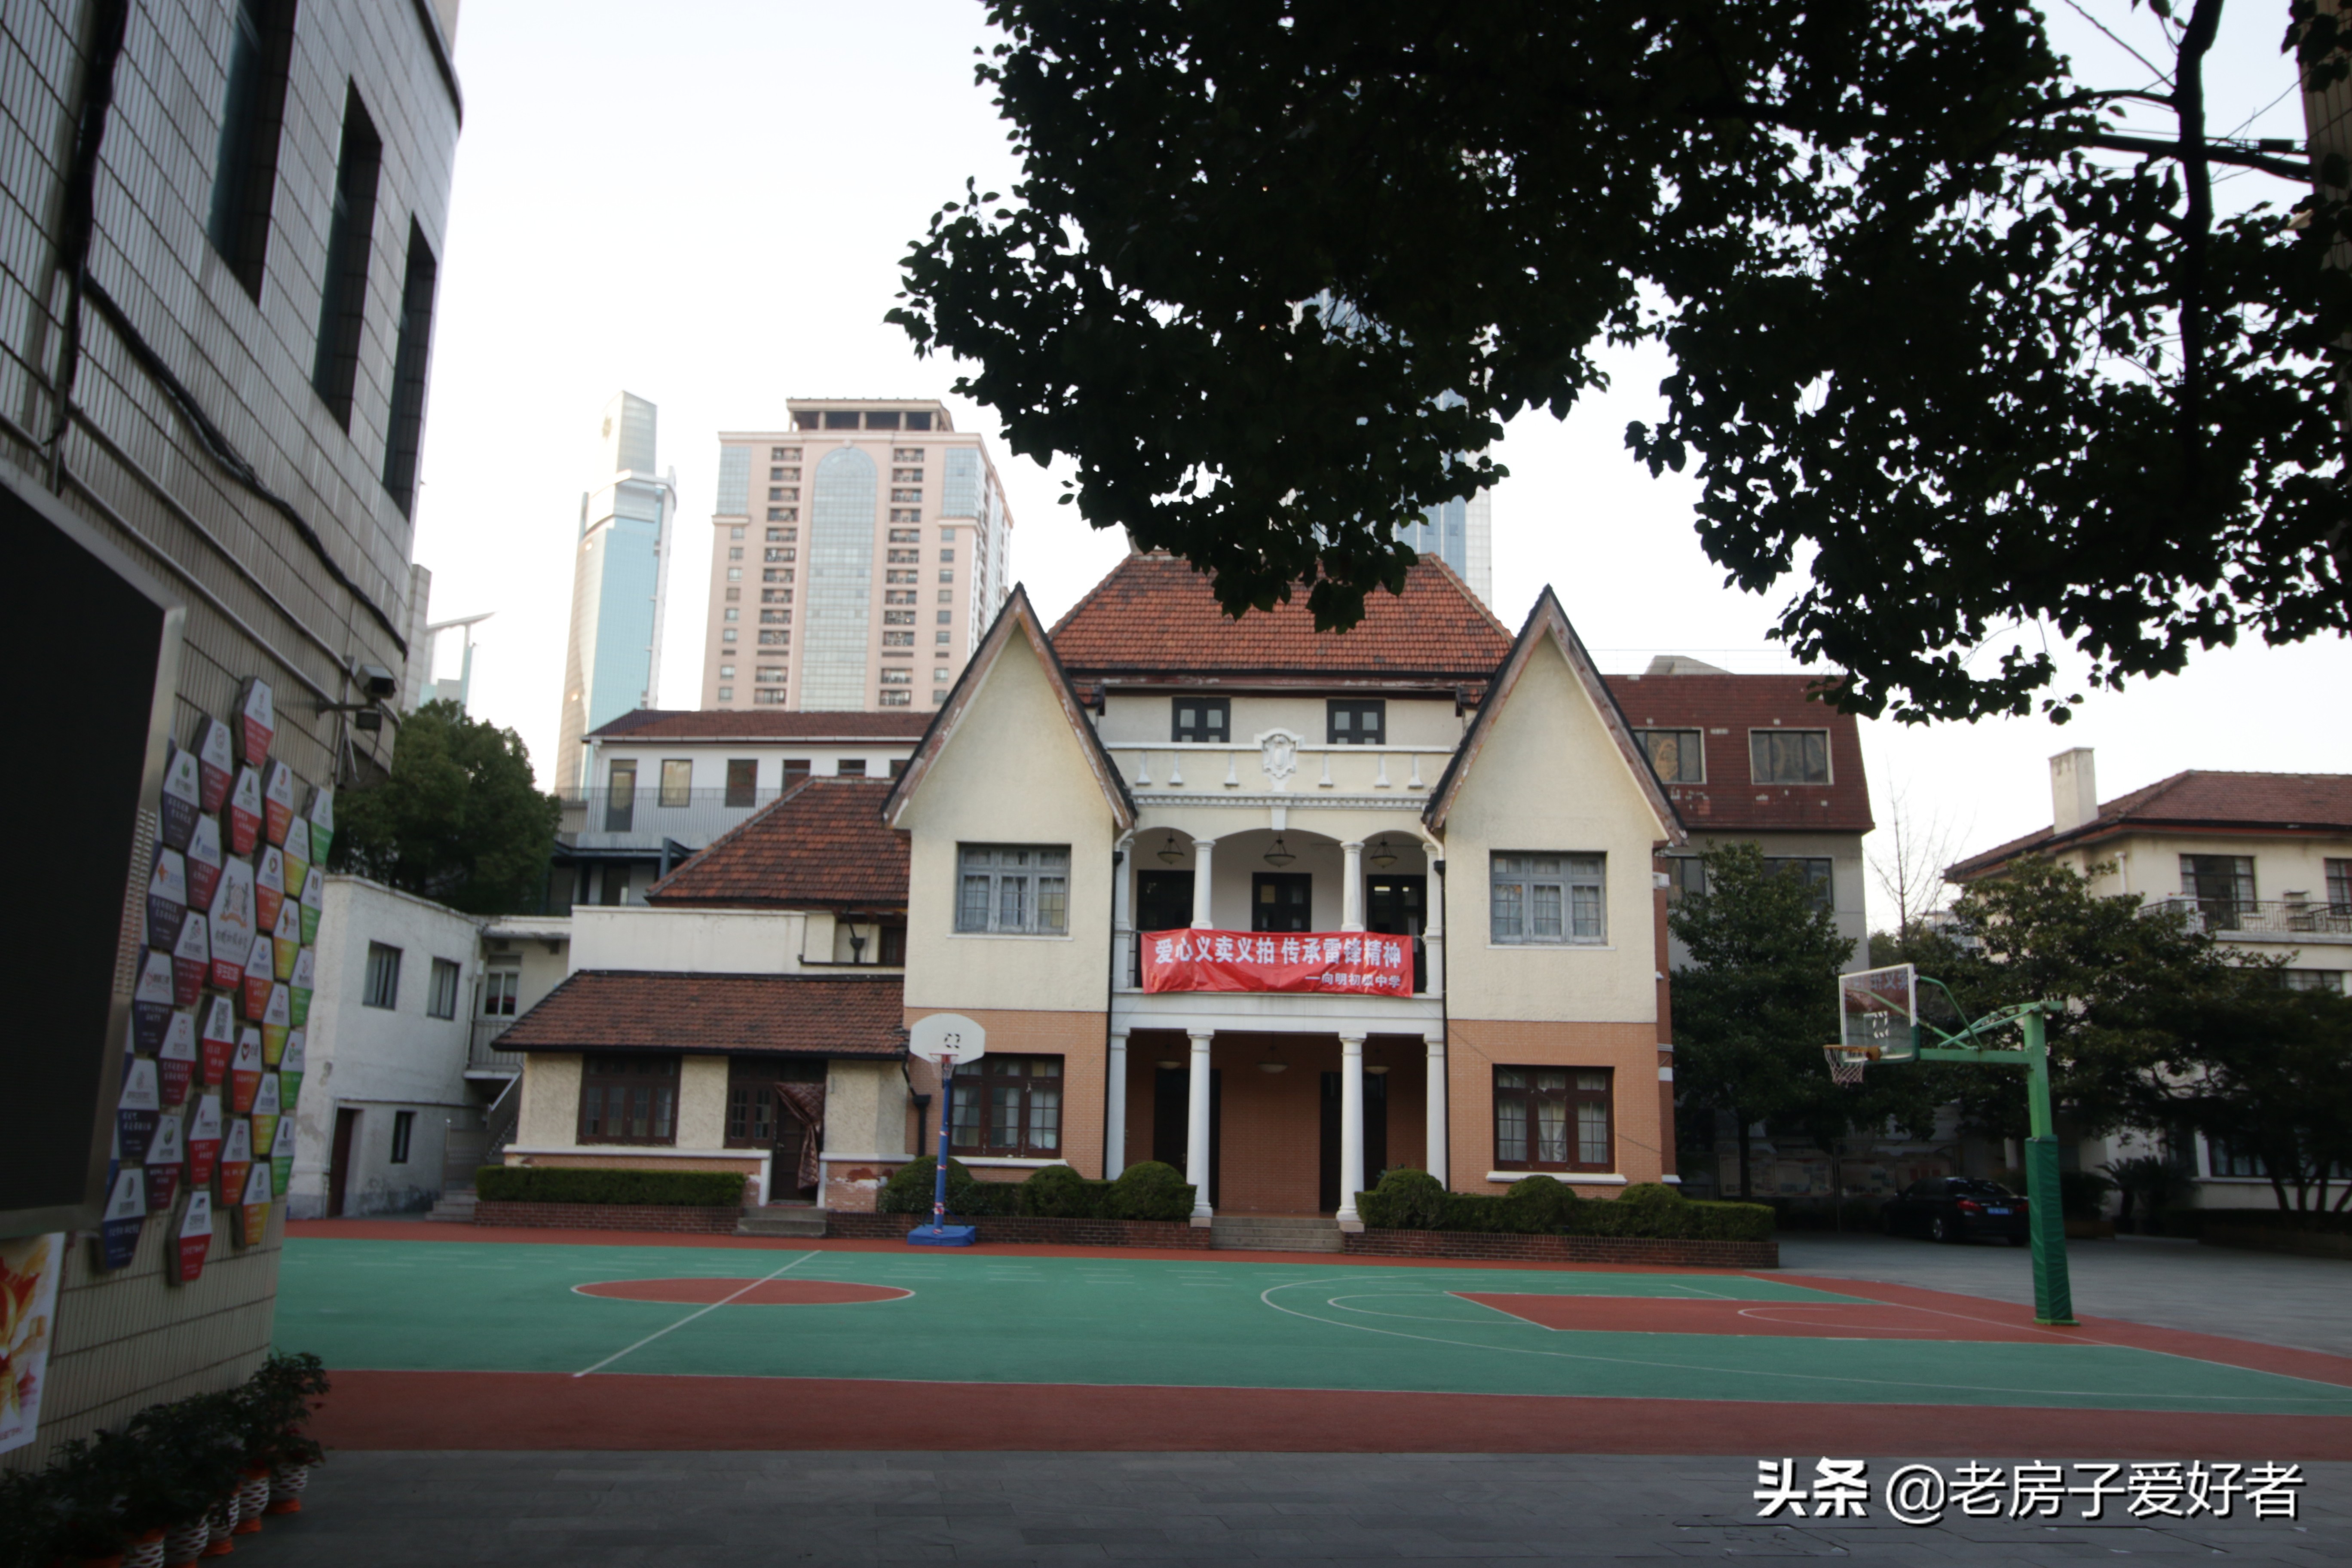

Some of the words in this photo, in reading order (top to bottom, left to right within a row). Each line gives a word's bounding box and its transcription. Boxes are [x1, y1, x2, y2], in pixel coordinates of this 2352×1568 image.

[1155, 936, 1274, 964] 爱心义卖义拍
[1281, 937, 1402, 968] 传承雷锋精神
